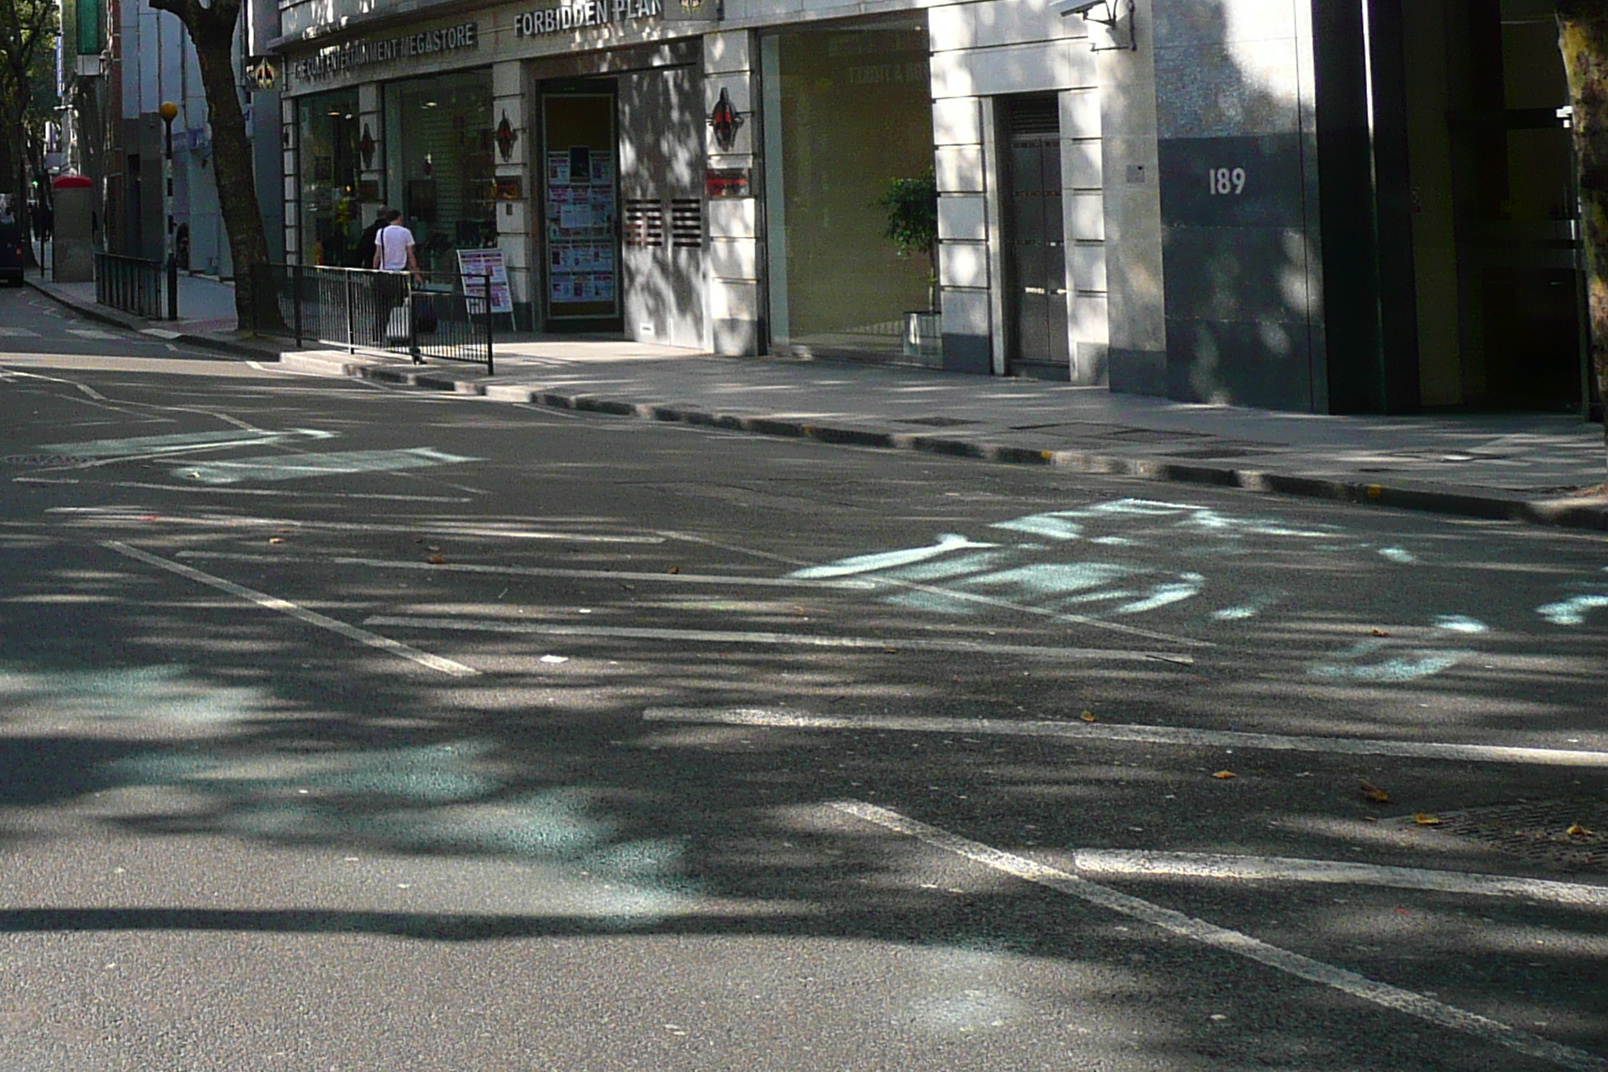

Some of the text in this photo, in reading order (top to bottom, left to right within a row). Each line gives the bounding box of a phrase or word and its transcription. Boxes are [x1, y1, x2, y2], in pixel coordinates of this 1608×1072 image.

[327, 39, 397, 72] ENTERTAINMENT
[401, 24, 473, 57] MEGASTORE
[1209, 168, 1246, 195] 189
